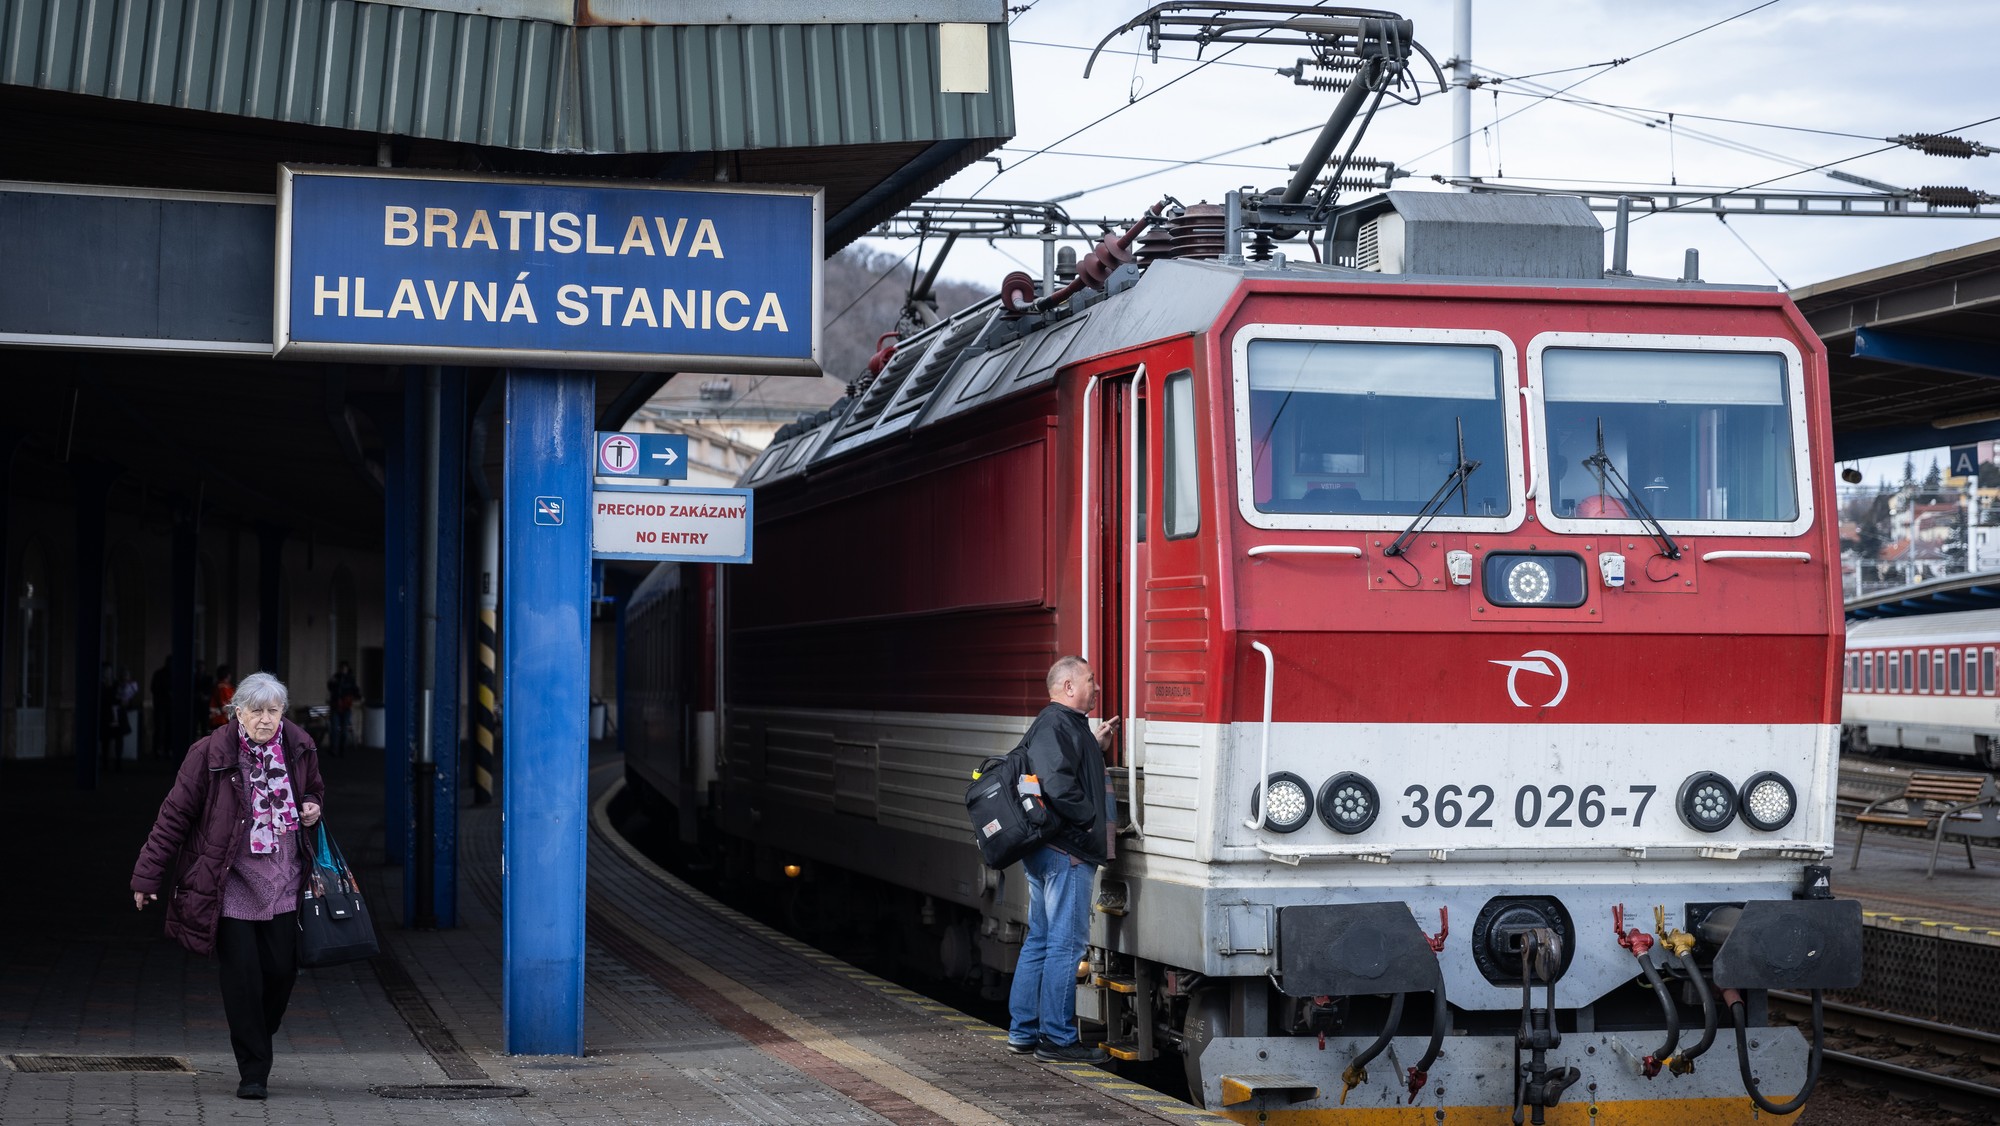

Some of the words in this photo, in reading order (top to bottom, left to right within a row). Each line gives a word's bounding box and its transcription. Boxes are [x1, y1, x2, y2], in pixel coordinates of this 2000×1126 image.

[383, 205, 725, 259] BRATISLAVA
[313, 271, 538, 324] HLAVNÁ
[556, 284, 789, 332] STANICA
[1956, 452, 1974, 472] A
[597, 503, 666, 517] PRECHOD
[669, 503, 747, 519] ZAKÁZANÝ
[636, 531, 657, 543] NO
[661, 532, 709, 545] ENTRY
[1401, 784, 1495, 828] 362
[1514, 784, 1657, 828] 026-7
